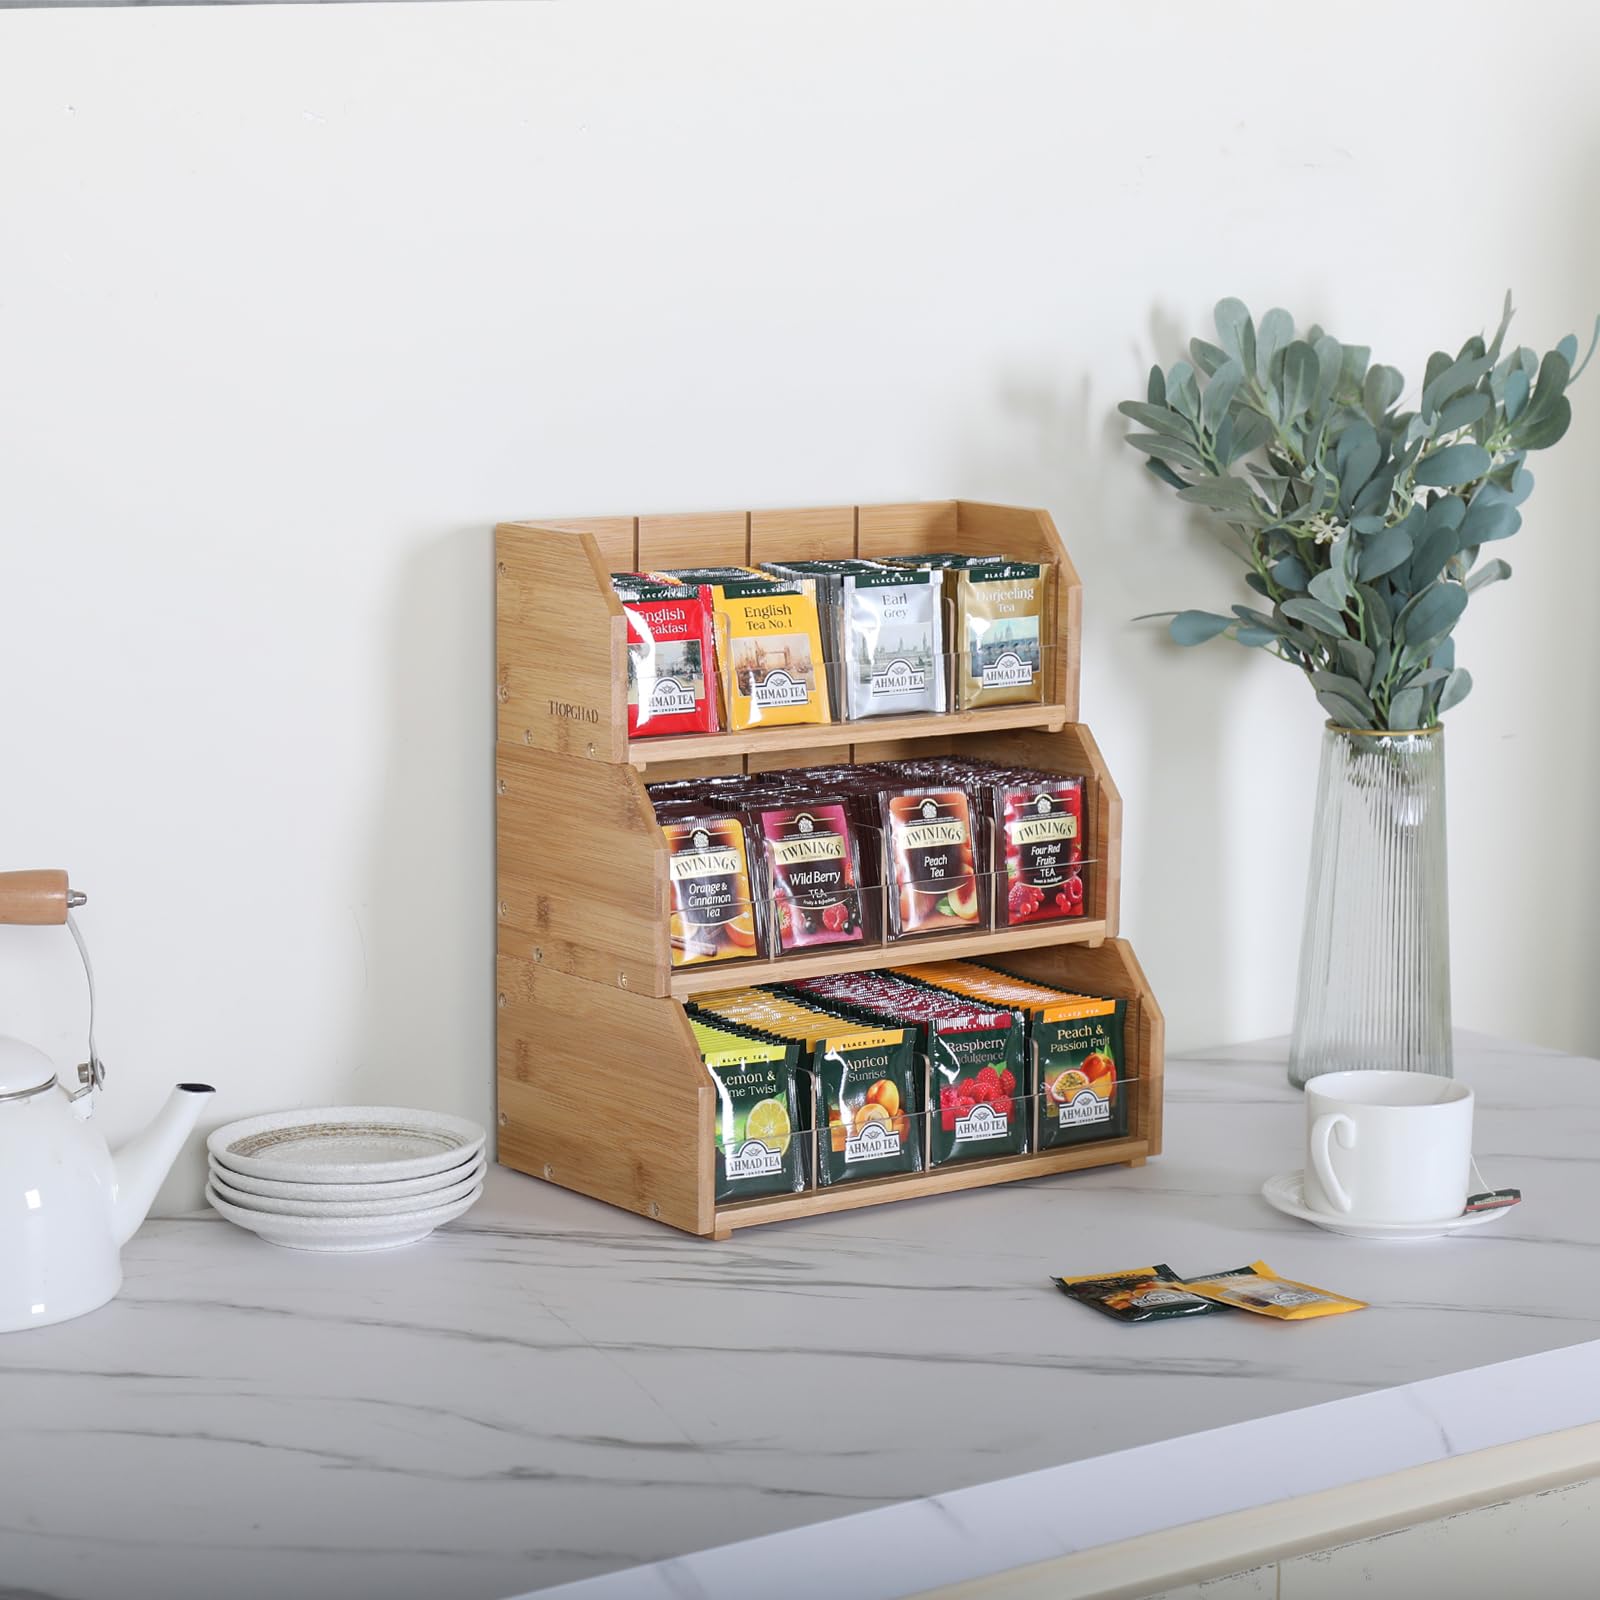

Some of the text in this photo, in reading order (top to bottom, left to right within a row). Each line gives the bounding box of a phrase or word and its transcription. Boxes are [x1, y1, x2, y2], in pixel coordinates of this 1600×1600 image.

[1011, 571, 1026, 579] TEA
[881, 592, 907, 606] Earl
[976, 586, 1034, 604] Darjeeling
[743, 604, 792, 620] English
[883, 608, 907, 620] Grey
[998, 603, 1015, 613] Tea
[636, 623, 688, 635] eakfast
[745, 620, 765, 631] Tea
[984, 668, 1031, 681] AHMAD TEA
[874, 675, 924, 689] AHMAD TEA
[648, 693, 694, 707] HMAD TEA
[756, 687, 806, 700] AHMAD TEA
[905, 826, 961, 846] TWININGS
[1016, 822, 1072, 842] TWININGS
[779, 841, 841, 861] TWININGS
[1030, 843, 1061, 857] Four Red
[674, 855, 736, 877] TWININGS
[924, 854, 948, 867] Peach
[1035, 855, 1056, 866] Fruits
[789, 871, 841, 886] Wild Berry
[930, 867, 945, 878] Tea
[1039, 867, 1055, 878] TEA
[689, 882, 728, 895] Orange &
[808, 888, 827, 899] TEA
[688, 893, 731, 907] Cinnamon
[705, 907, 720, 918] Tea
[1057, 1024, 1104, 1040] Peach &
[947, 1038, 1007, 1054] Raspberry
[1050, 1036, 1110, 1053] Passion Fruit
[846, 1055, 889, 1072] Apricot
[951, 1052, 1004, 1065] Indulgence
[767, 1070, 776, 1081] &
[848, 1069, 887, 1083] Sunrise
[724, 1083, 777, 1098] me Twist
[1061, 1103, 1108, 1120] AHMAD TEA
[957, 1119, 1006, 1135] AHMAD TEA
[848, 1137, 898, 1155] AHMAD TEA
[729, 1155, 780, 1172] AHMAD TEA
